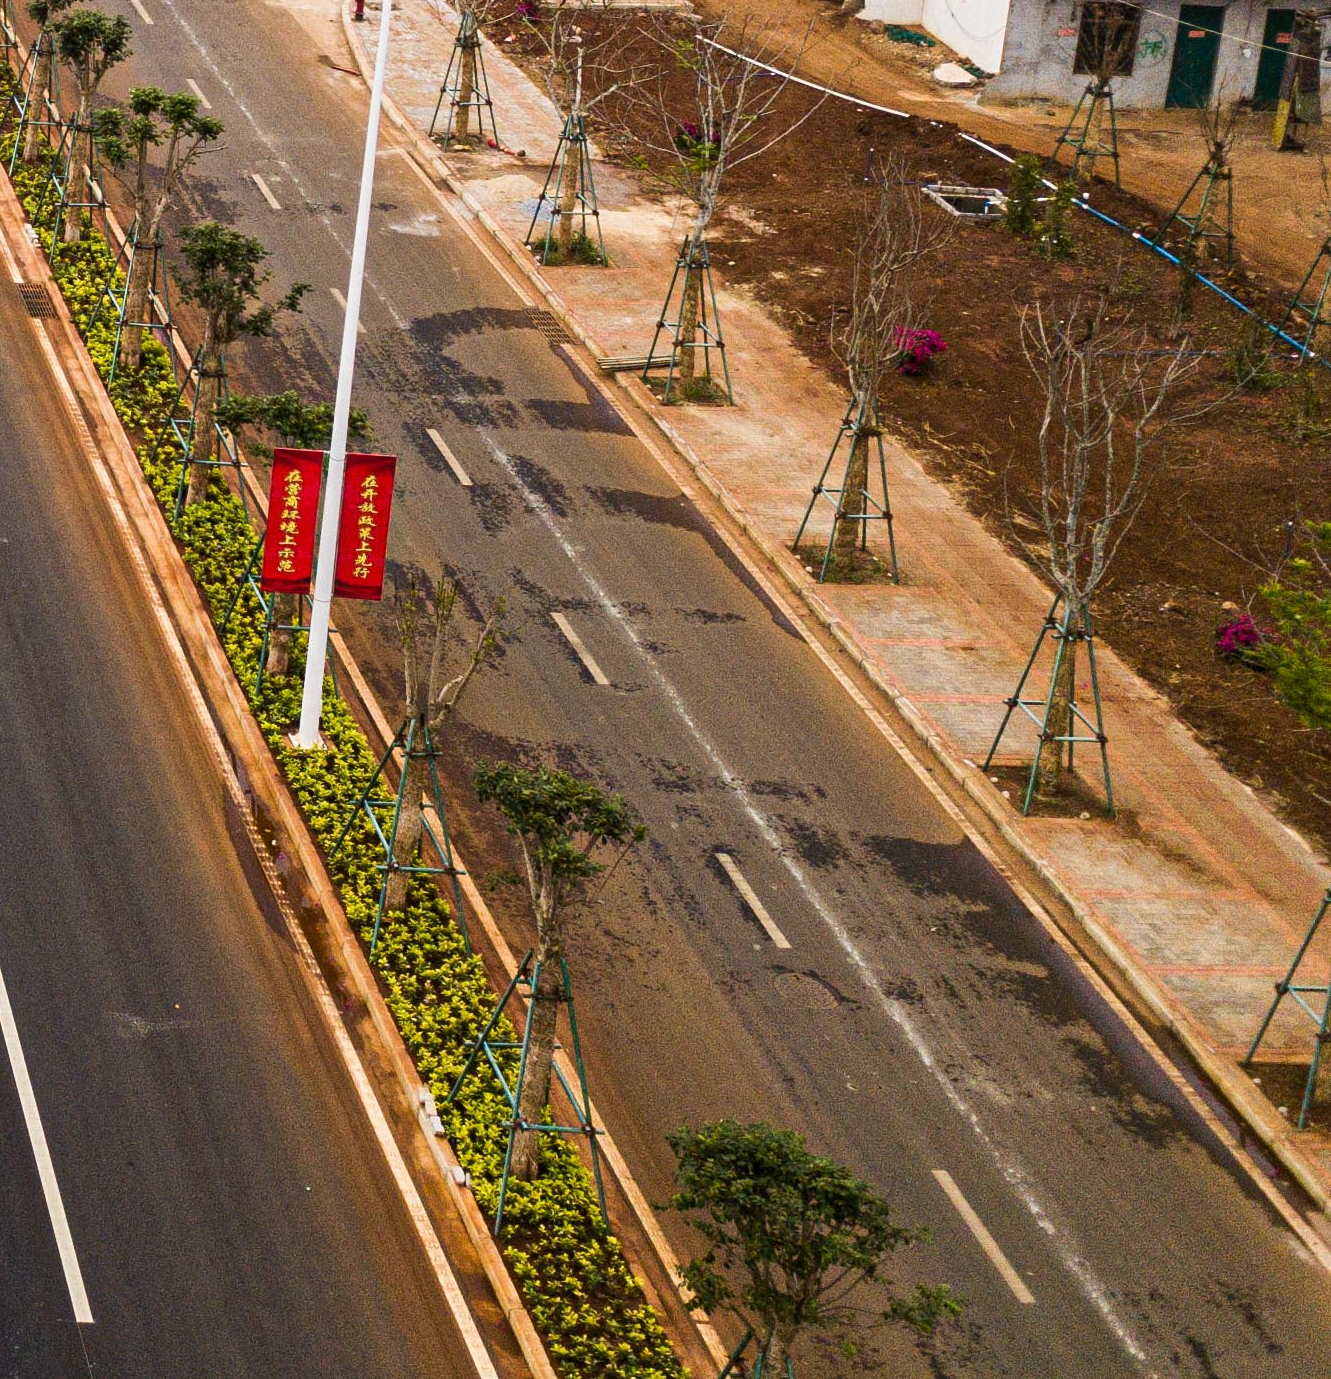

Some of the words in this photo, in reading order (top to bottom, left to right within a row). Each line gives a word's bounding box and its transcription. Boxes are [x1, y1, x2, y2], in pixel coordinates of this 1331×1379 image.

[277, 469, 304, 573] 在营商环境上示范
[352, 475, 379, 580] 在开放政策上先行
